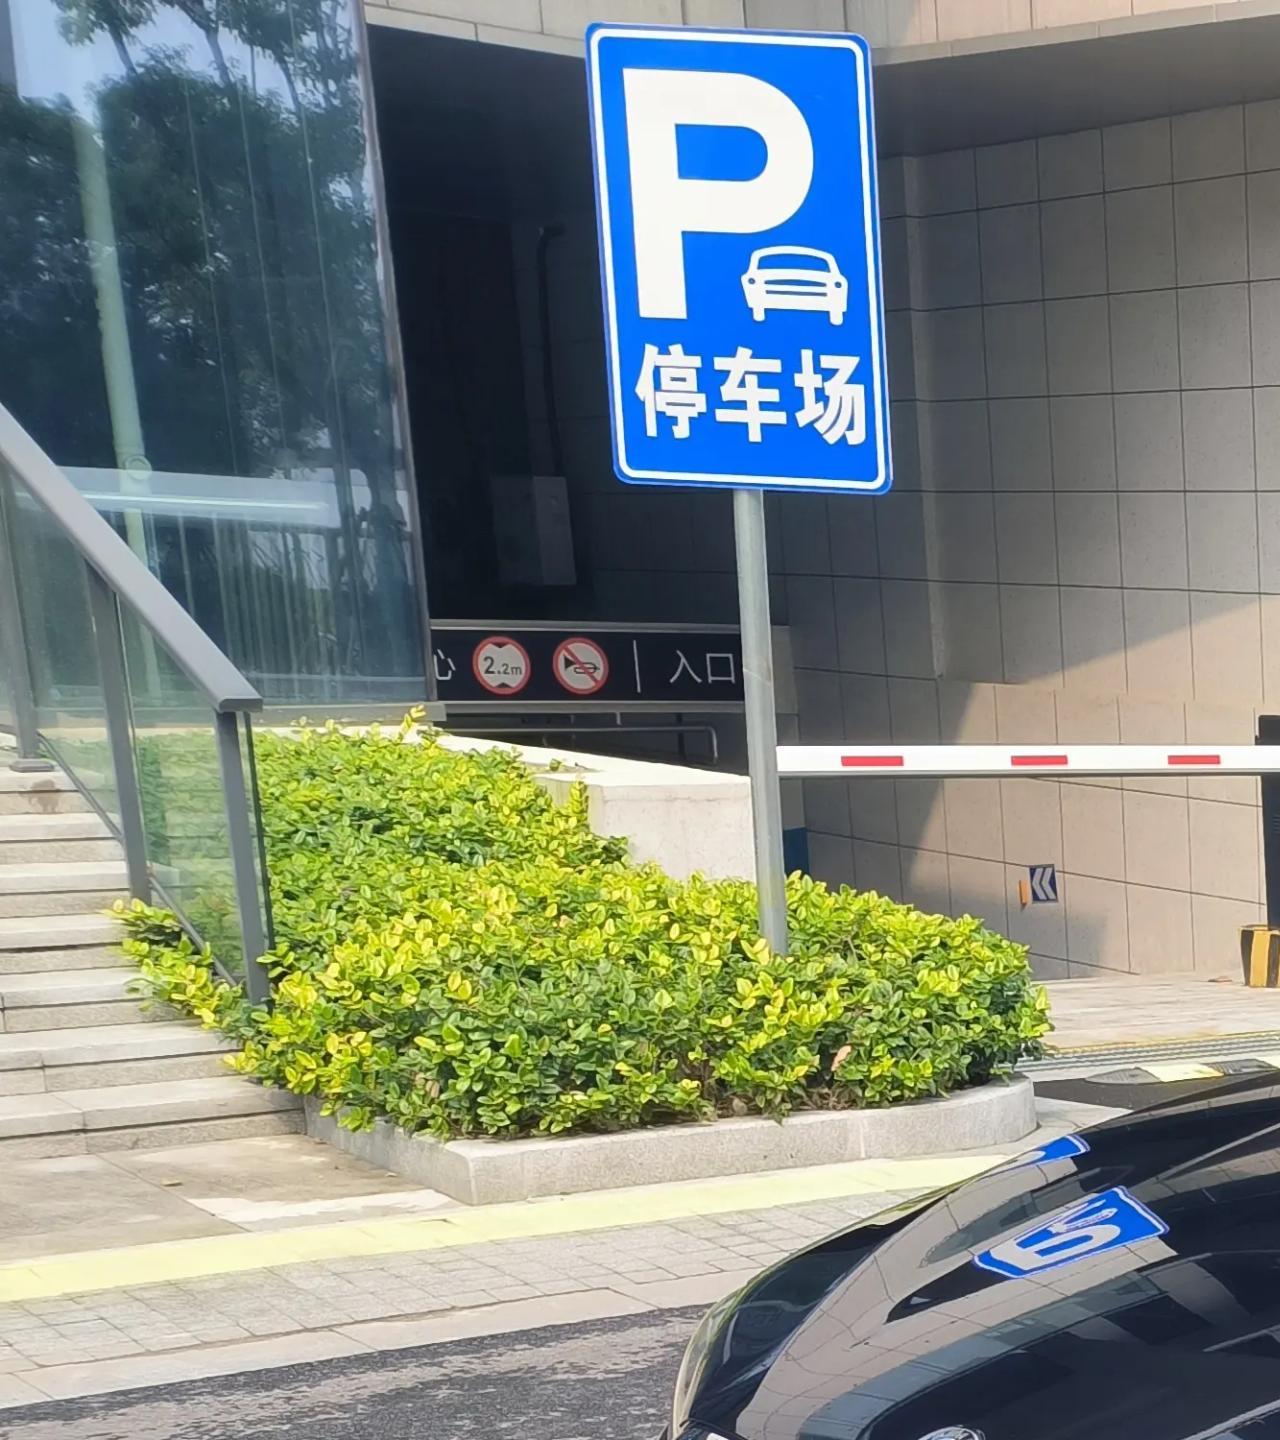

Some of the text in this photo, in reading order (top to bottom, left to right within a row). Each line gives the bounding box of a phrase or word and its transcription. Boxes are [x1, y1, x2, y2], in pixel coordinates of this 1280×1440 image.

[622, 67, 814, 320] P
[634, 343, 866, 446] 停车场
[483, 655, 523, 676] 2.2m
[669, 649, 736, 684] 入口
